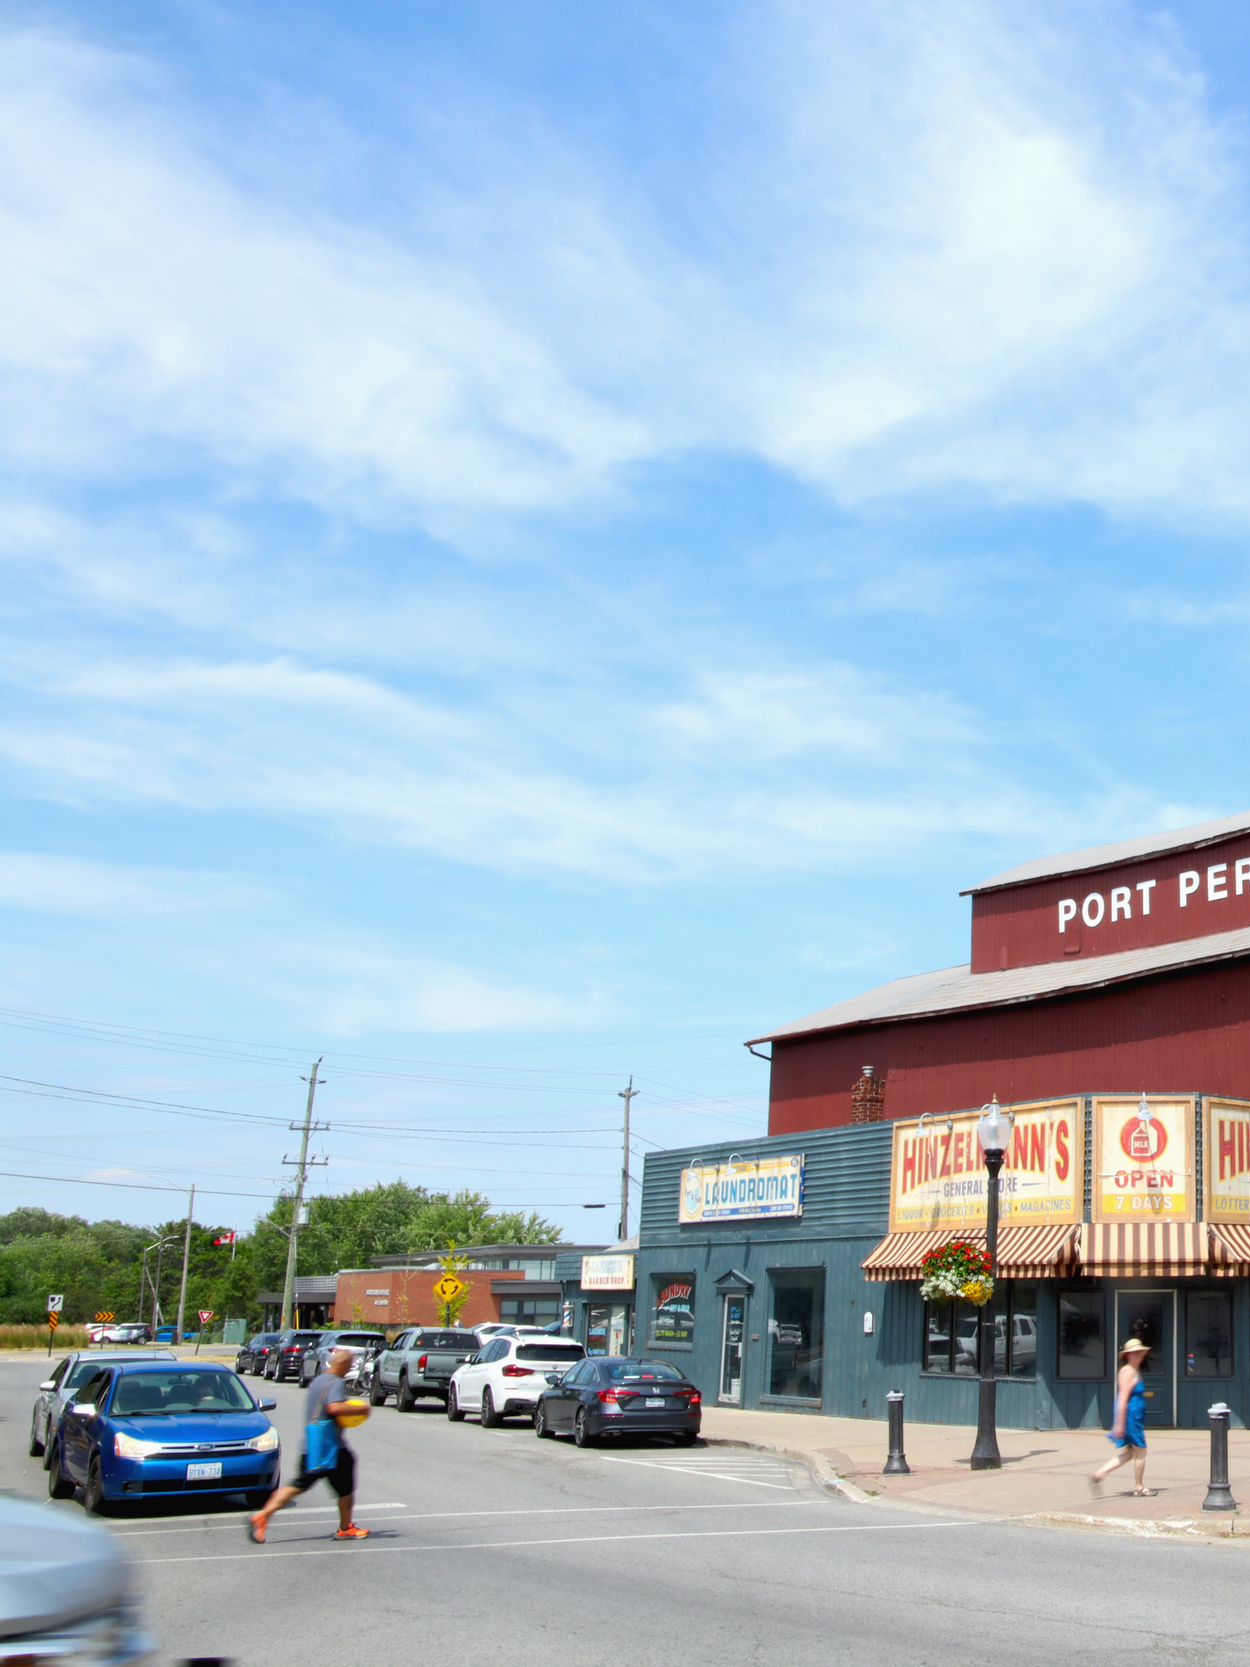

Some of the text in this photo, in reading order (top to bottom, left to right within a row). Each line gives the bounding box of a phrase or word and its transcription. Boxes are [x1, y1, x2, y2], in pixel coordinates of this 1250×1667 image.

[1058, 880, 1156, 933] PORT
[1134, 1140, 1149, 1149] MILK
[902, 1120, 1069, 1194] HINZELNN'S
[943, 1177, 1018, 1197] GENERAL ORE
[1115, 1170, 1173, 1188] OPEN
[705, 1174, 797, 1205] LAUNDROMAT
[897, 1199, 1071, 1220] LIQUOR GROCERIES VOS MAGAZINES
[1115, 1196, 1173, 1210] 7 DAYS
[589, 1276, 624, 1285] BARBER SHOP
[656, 1283, 692, 1310] LAUNDRY
